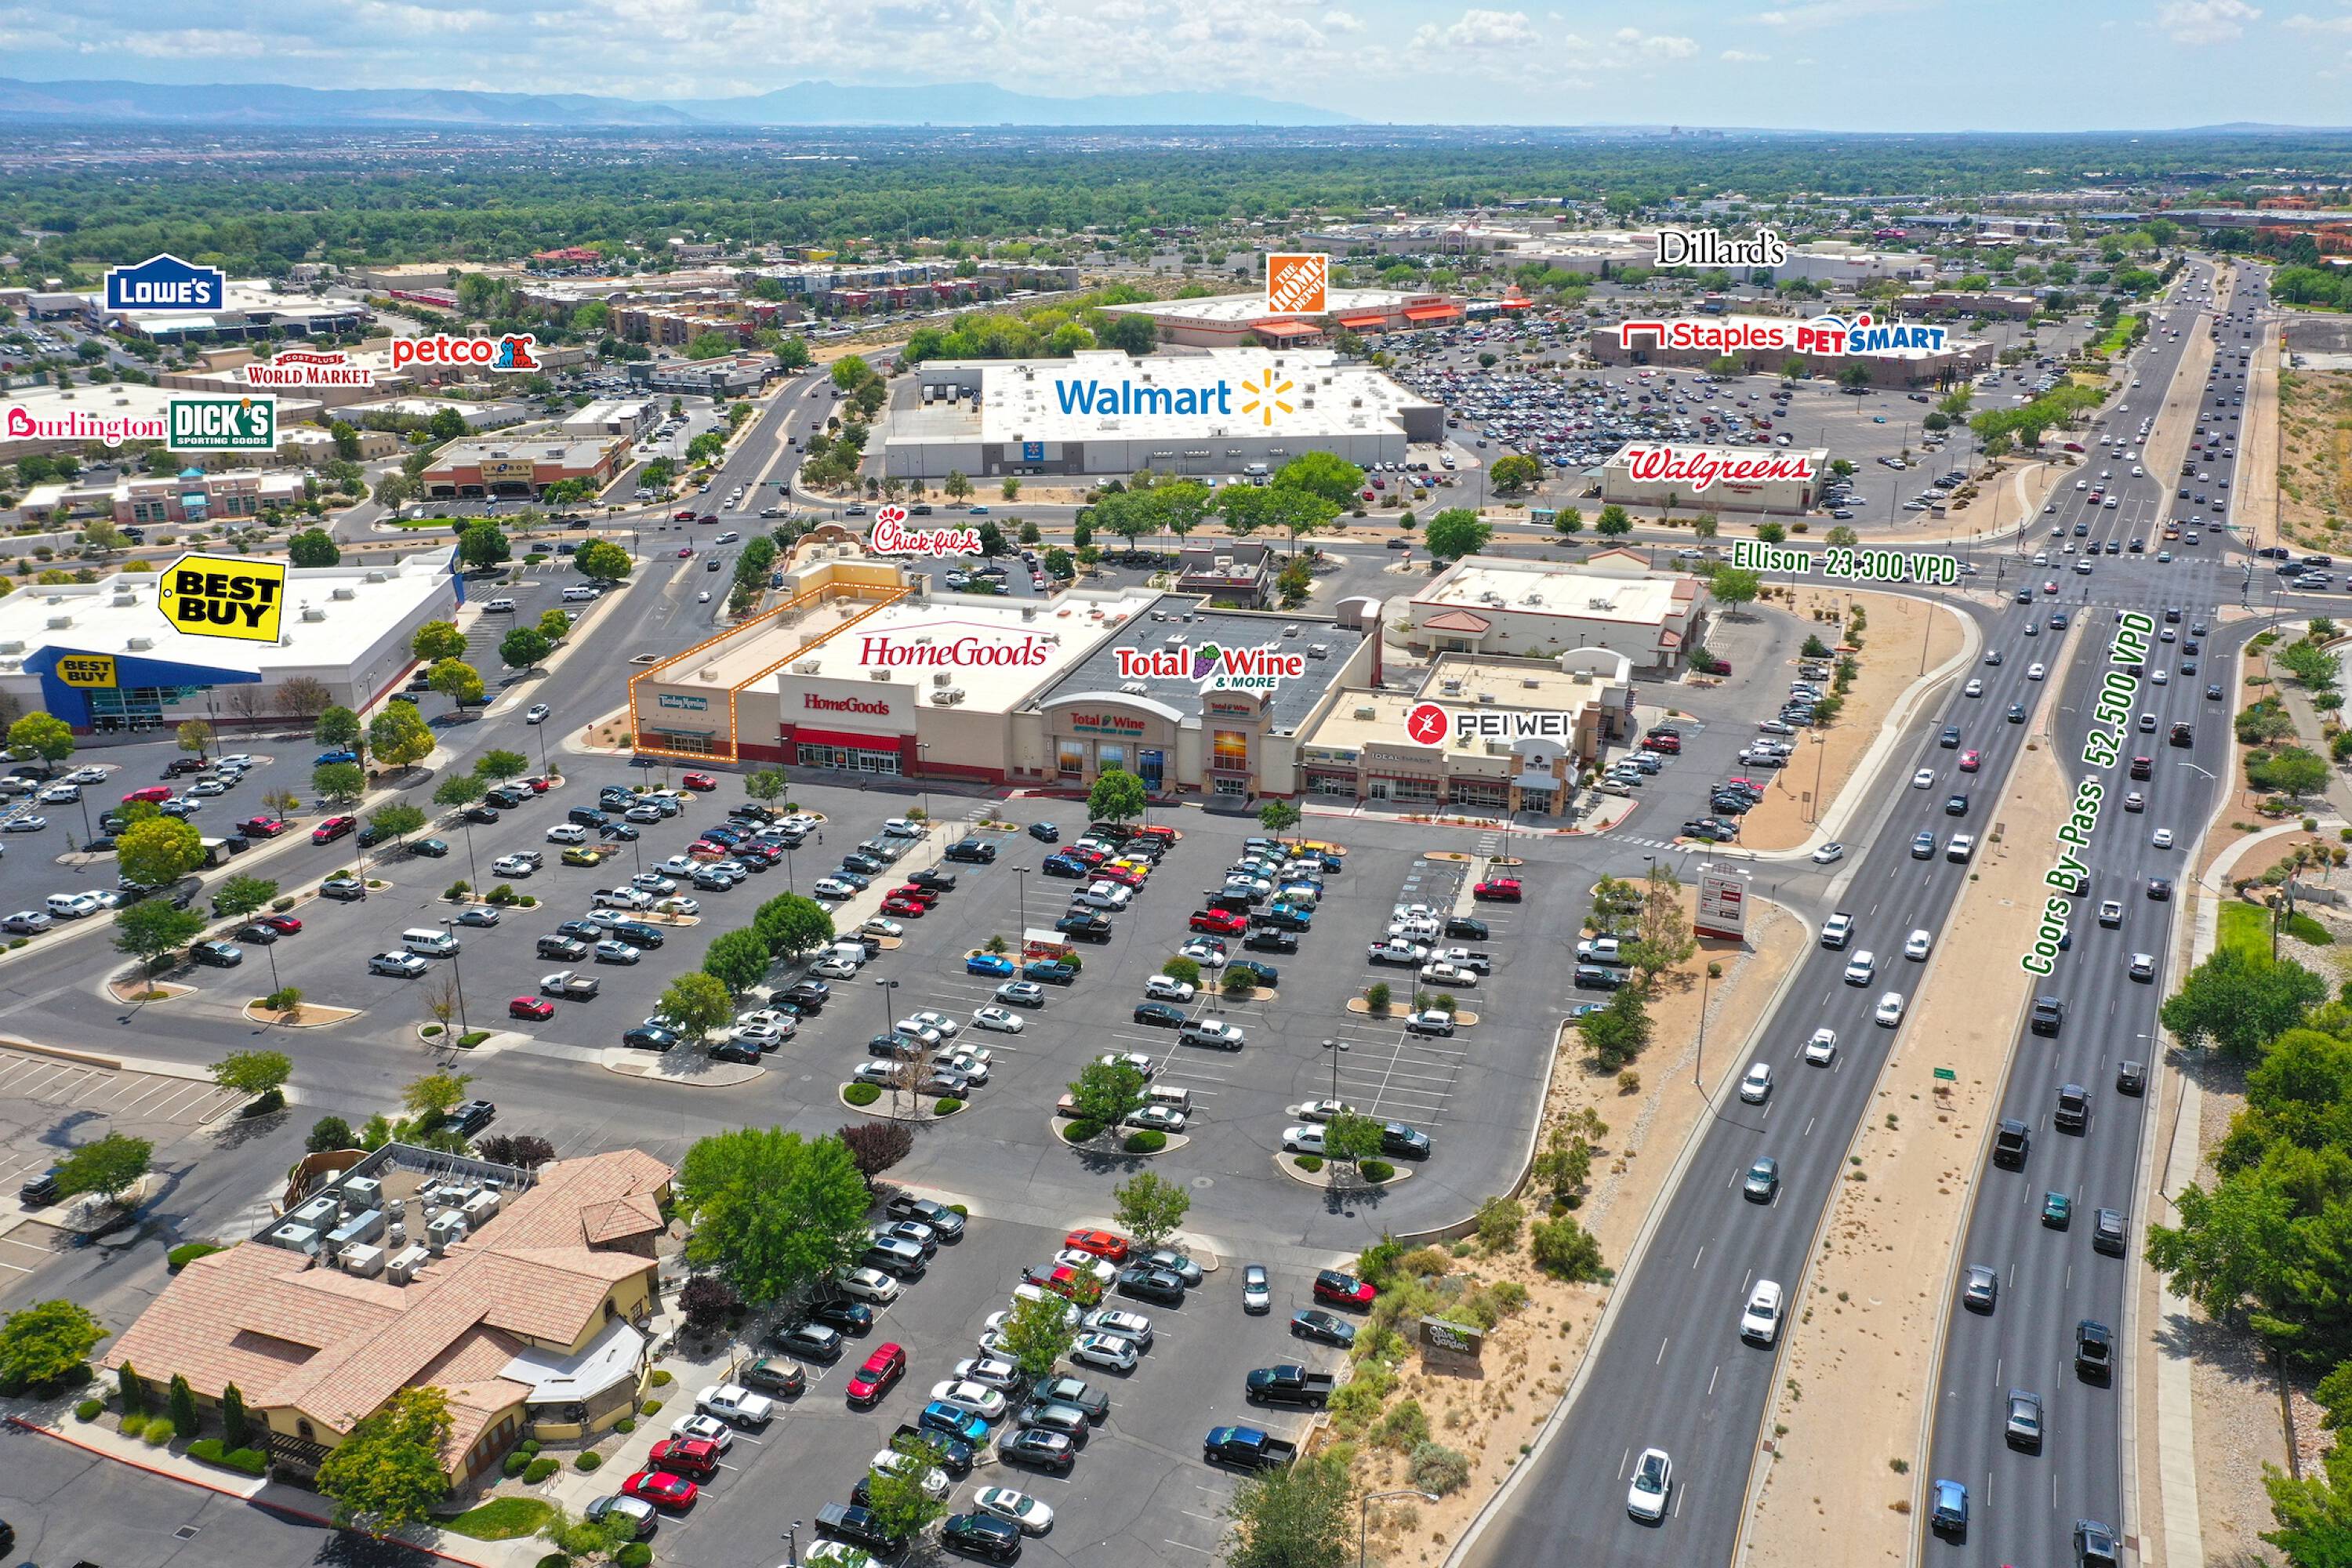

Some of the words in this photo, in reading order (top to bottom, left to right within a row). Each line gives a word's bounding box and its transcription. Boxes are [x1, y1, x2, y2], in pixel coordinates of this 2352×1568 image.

[64, 660, 111, 672] BEST
[67, 671, 108, 682] BUY
[804, 693, 890, 715] HomeGoods
[1070, 712, 1100, 726] Total
[1112, 715, 1145, 729] Wine
[1371, 753, 1399, 761] IDEAL
[1429, 1326, 1455, 1340] Olive
